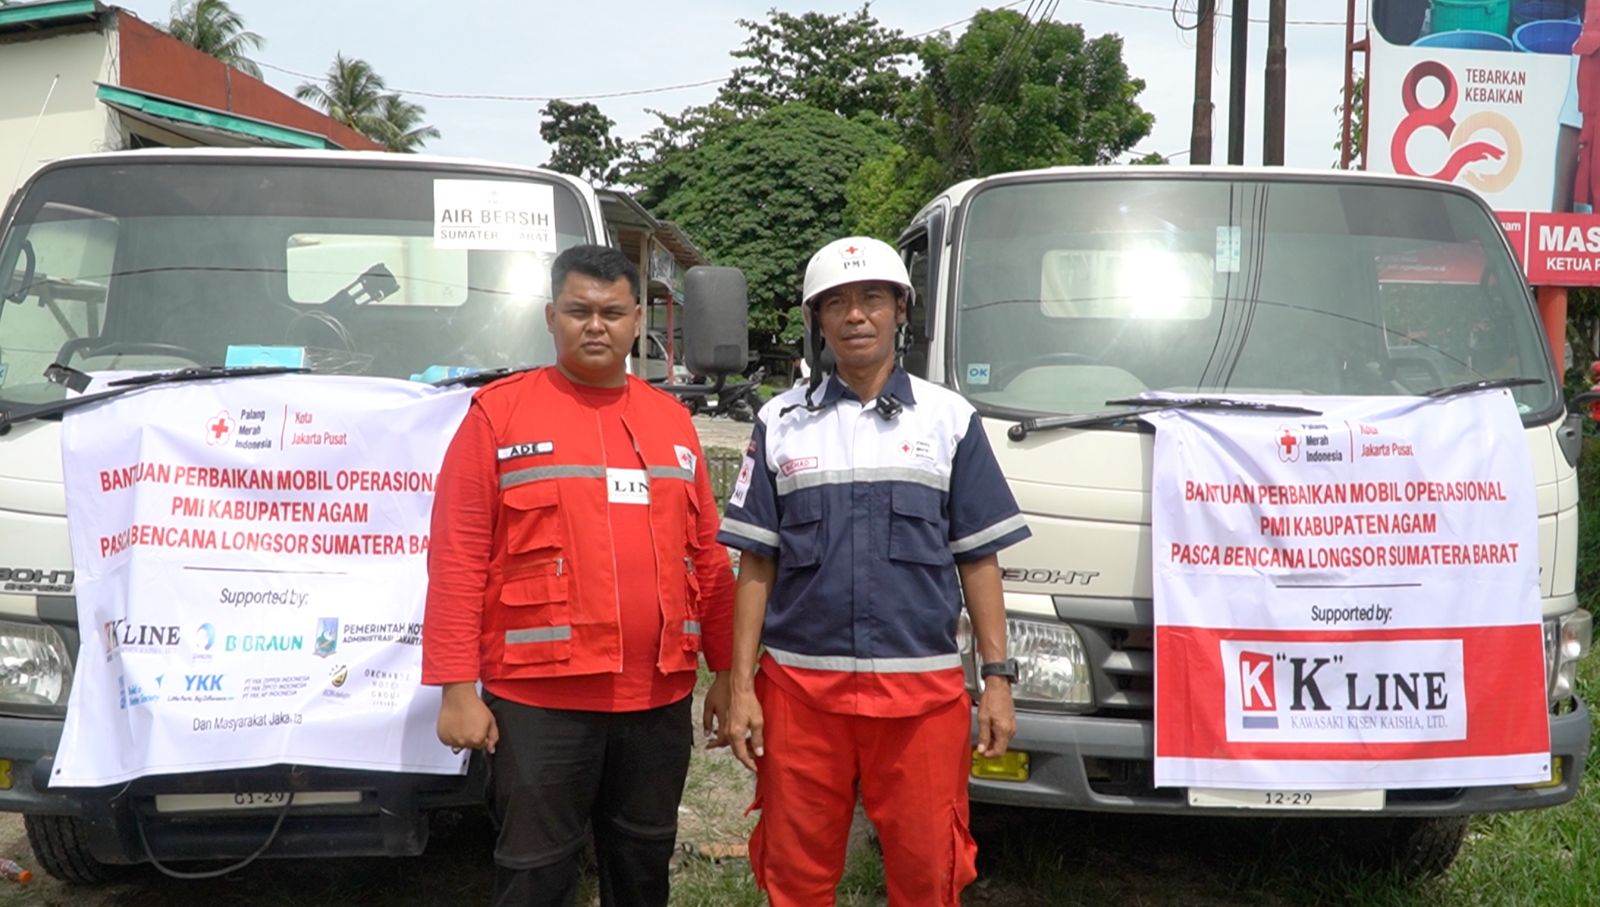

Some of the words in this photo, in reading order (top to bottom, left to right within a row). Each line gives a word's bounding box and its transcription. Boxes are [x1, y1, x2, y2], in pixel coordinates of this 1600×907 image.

[1465, 68, 1526, 86] TEBARKAN
[1464, 87, 1523, 105] KEBAIKAN
[441, 208, 473, 223] AIR
[480, 209, 549, 227] BERSIH
[440, 229, 504, 241] SUMATER
[843, 259, 866, 270] PMI
[1546, 256, 1593, 272] KETUA
[969, 367, 988, 377] OK
[240, 408, 266, 421] Palang
[295, 411, 313, 424] Kota
[238, 425, 261, 436] Merah
[291, 432, 322, 446] Jakarta
[323, 431, 347, 446] Pusat
[235, 438, 272, 449] Indonesia
[1305, 434, 1329, 446] Merah
[510, 443, 539, 456] ADE
[1305, 449, 1343, 462] Indonesia
[1361, 443, 1391, 457] Jakarta
[99, 462, 172, 492] BANTUAN
[174, 465, 273, 491] PERBAIKAN
[277, 469, 333, 491] MOBIL
[336, 470, 439, 492] OPERASION
[614, 480, 650, 493] LIN
[1185, 480, 1255, 505] BANTUAN
[1258, 483, 1346, 505] PERBAIKAN
[1350, 481, 1403, 503] MOBIL
[1404, 481, 1507, 502] OPERASIONAL
[171, 496, 205, 518] PMI
[208, 499, 315, 522] KABUPATEN
[317, 502, 369, 523] AGAM
[1260, 515, 1290, 537] PMI
[1293, 514, 1389, 537] KABUPATEN
[1391, 513, 1437, 534] AGAM
[129, 524, 217, 550] BENCANA
[221, 531, 309, 554] LONGSOR
[311, 533, 406, 555] SUMATERA
[409, 534, 431, 555] BA
[1171, 542, 1220, 565] PASCA
[1223, 545, 1306, 568] BENCANA
[1308, 545, 1387, 569] LONGSOR
[1388, 544, 1471, 566] SUMATERA
[1473, 543, 1519, 564] BARAT
[219, 587, 288, 607] Supported
[289, 589, 309, 607] by:
[1311, 604, 1375, 624] Supported
[1375, 604, 1393, 624] by:
[122, 624, 181, 646] LINE
[343, 622, 406, 635] PEMERINTAH
[242, 635, 304, 652] BRAUN
[342, 634, 395, 644] ADMINISTRASI
[184, 673, 225, 691] YKK
[1345, 671, 1448, 711] LINE
[192, 717, 212, 732] Dan
[213, 713, 267, 732] Masyarakat
[1290, 716, 1345, 730] KAWASAKI
[1347, 716, 1377, 730] KISEN
[1379, 715, 1425, 730] KAISHA,
[1426, 715, 1449, 729] LTD.
